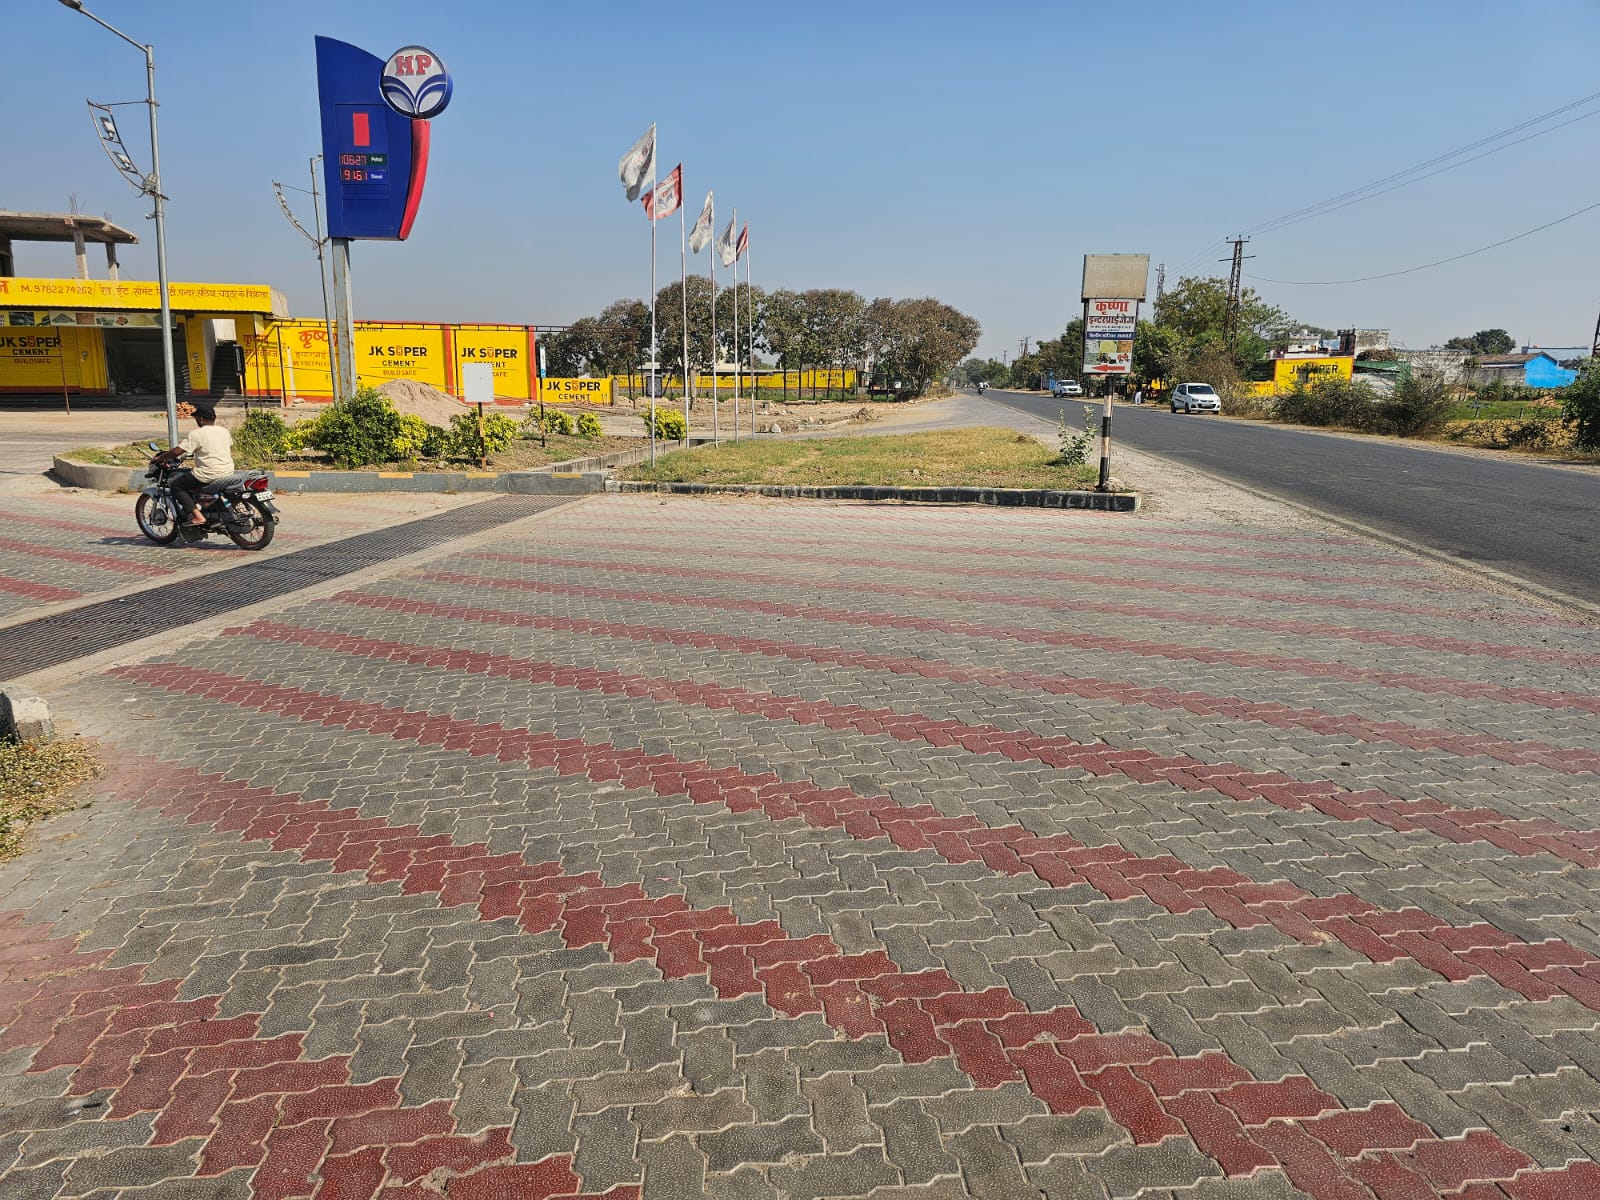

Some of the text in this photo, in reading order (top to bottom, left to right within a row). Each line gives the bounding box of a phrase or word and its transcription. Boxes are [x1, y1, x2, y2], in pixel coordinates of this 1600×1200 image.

[396, 54, 432, 76] HP
[1094, 301, 1130, 315] कृष्णा
[19, 336, 62, 348] SUPER
[368, 345, 428, 356] JK SUPER
[461, 347, 517, 359] JK SUPER
[546, 380, 600, 391] JK SUPER
